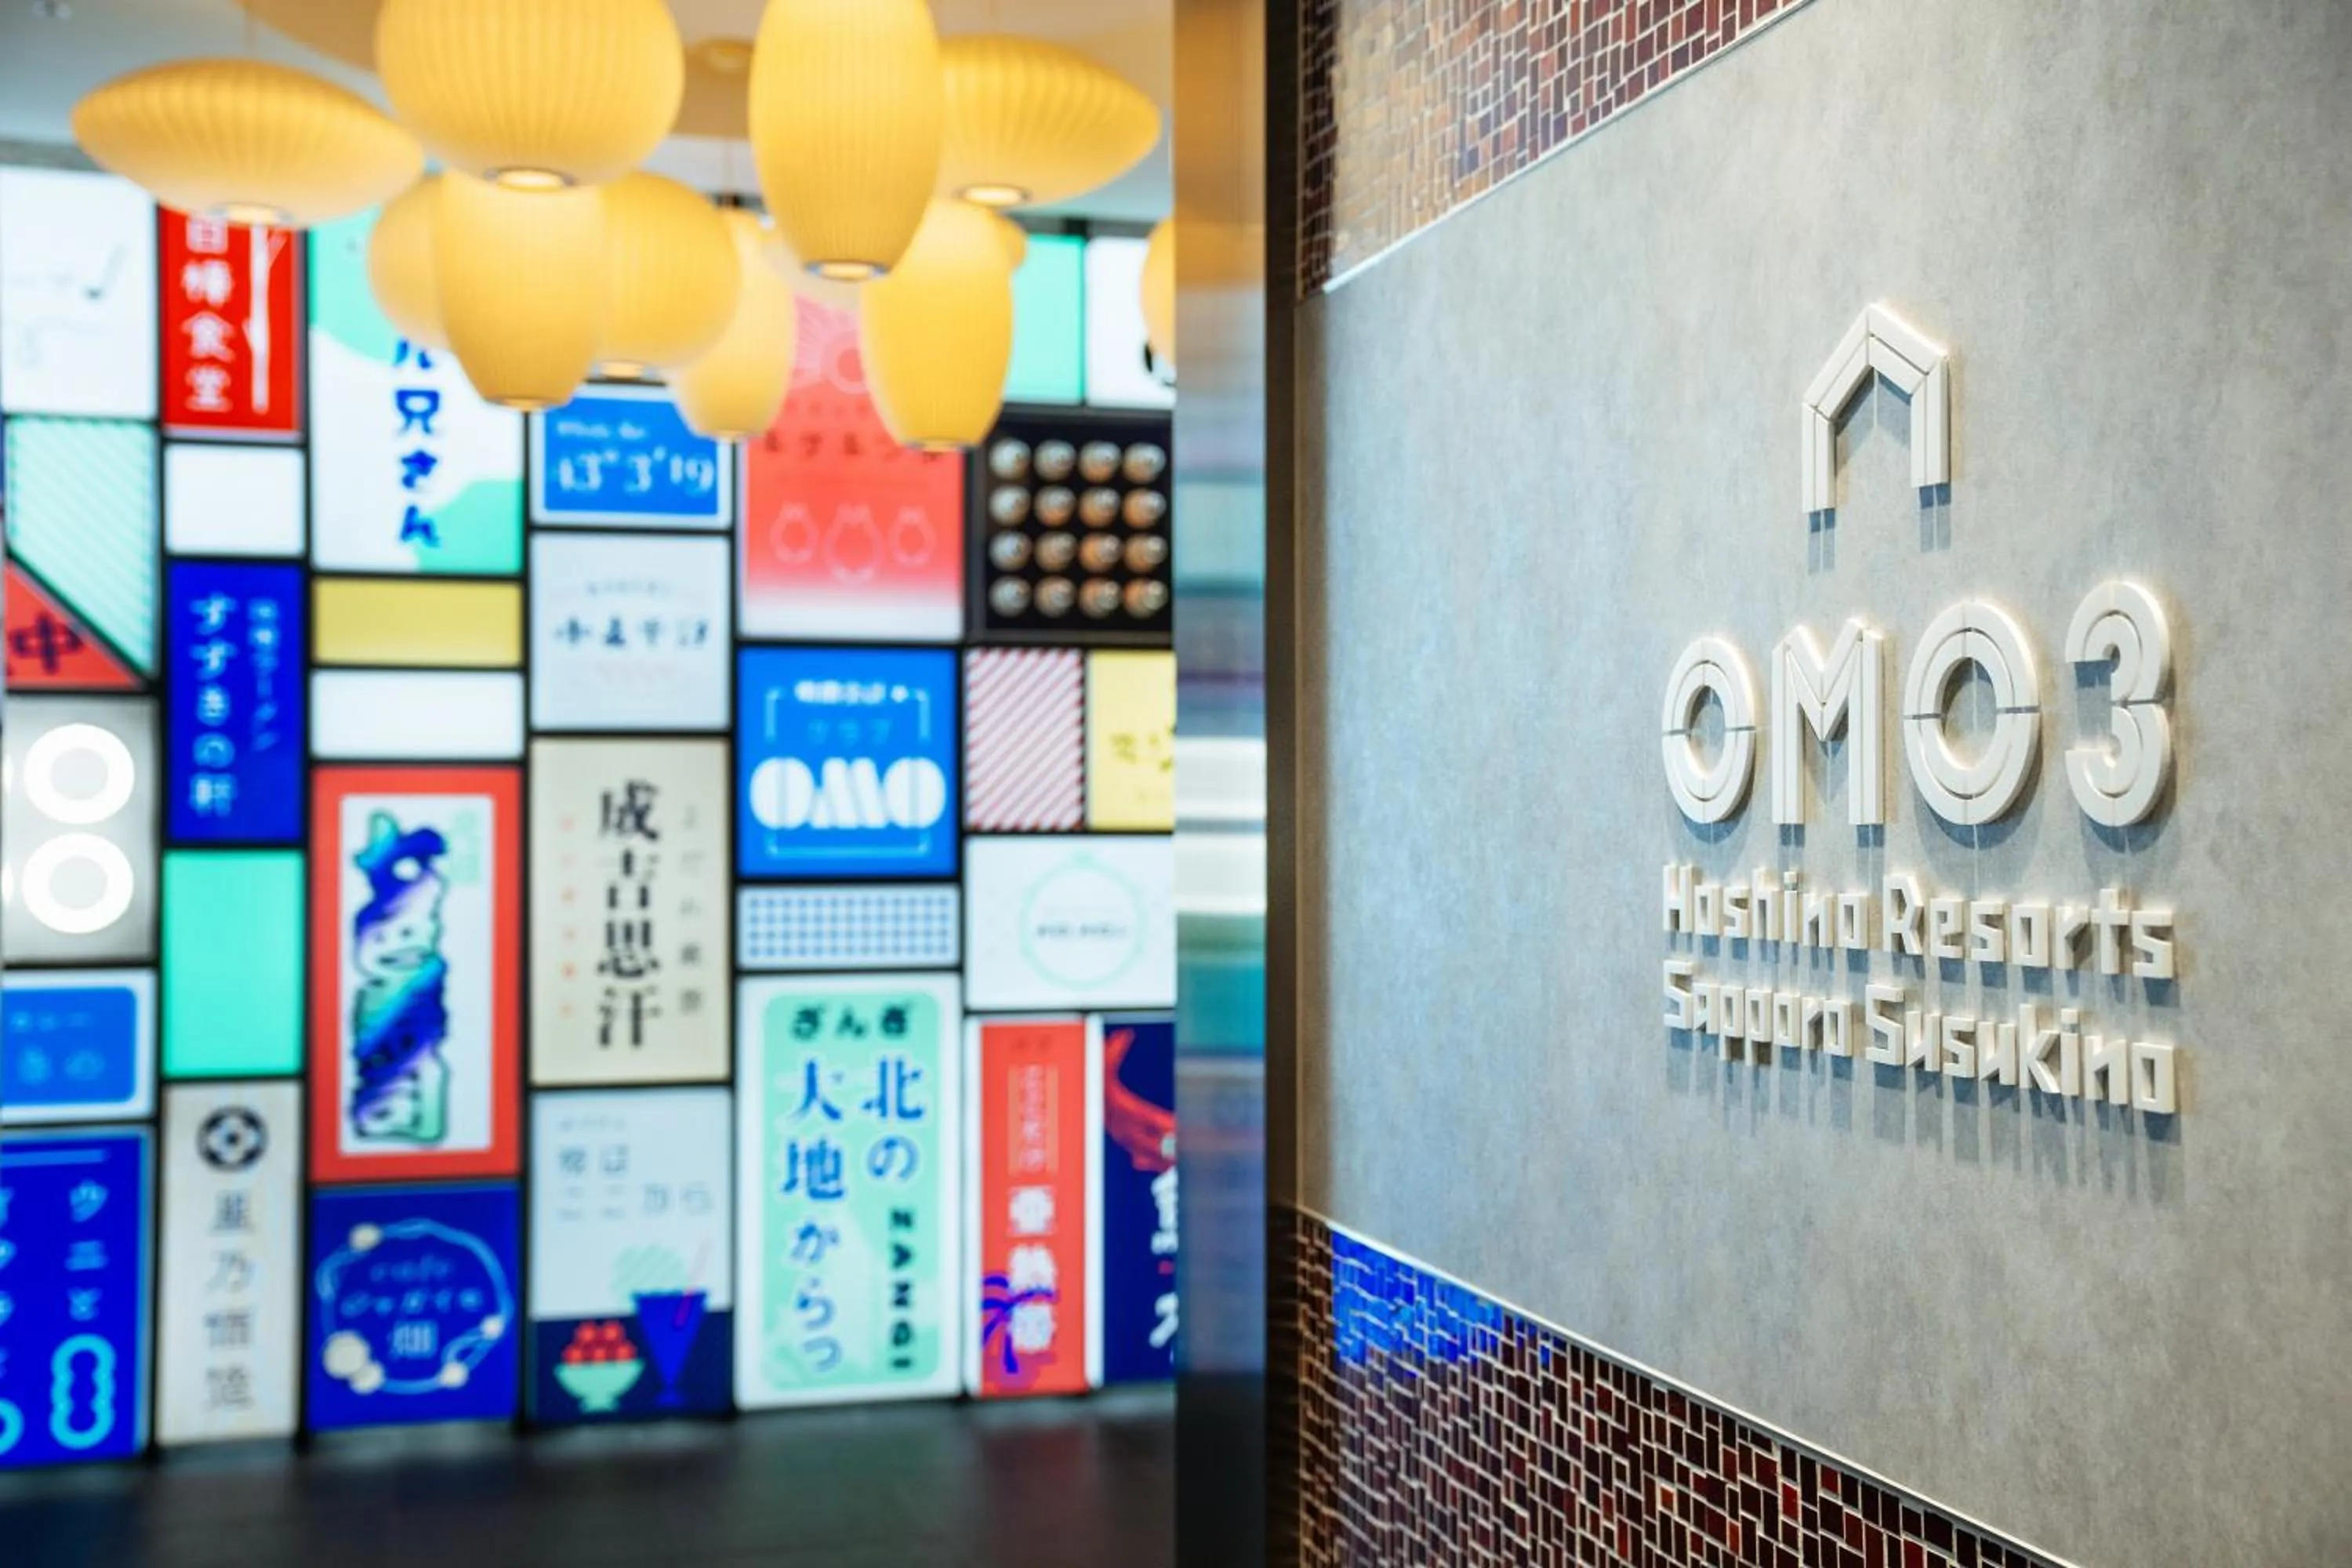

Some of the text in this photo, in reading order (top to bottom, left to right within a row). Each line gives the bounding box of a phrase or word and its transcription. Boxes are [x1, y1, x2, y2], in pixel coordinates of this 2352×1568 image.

[180, 213, 235, 413] 食堂
[1662, 580, 2171, 826] OMO3
[750, 756, 946, 829] OMO
[597, 779, 660, 1048] 成吉思汗
[1663, 864, 2173, 979] Hoshino Resorts
[1663, 960, 2175, 1113] Sapporo Susukino
[862, 1058, 924, 1181] 北の
